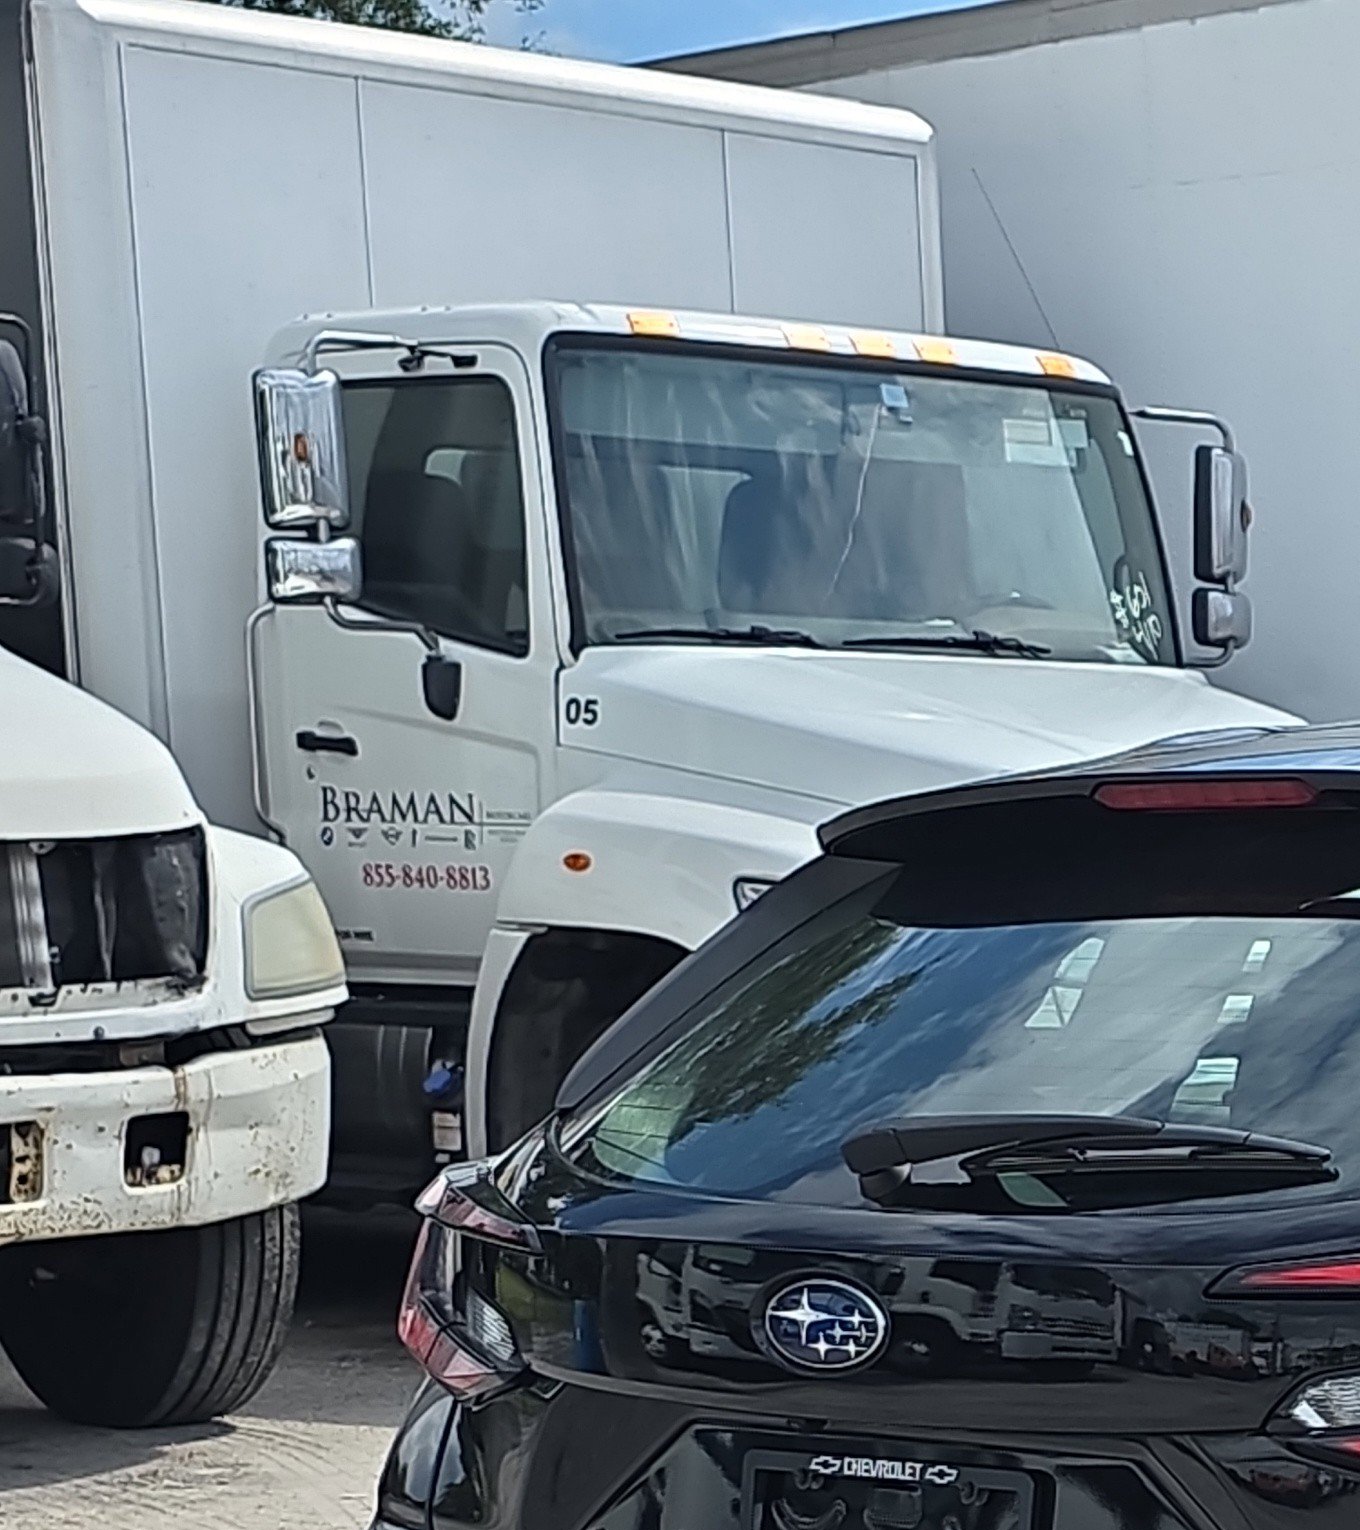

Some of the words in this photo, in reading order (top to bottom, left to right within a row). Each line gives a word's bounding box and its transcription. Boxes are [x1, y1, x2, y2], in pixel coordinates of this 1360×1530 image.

[565, 697, 599, 726] 05
[320, 785, 475, 825] BRAMAN
[362, 862, 492, 891] 855-840-8813
[843, 1457, 924, 1481] CHEVROLET
